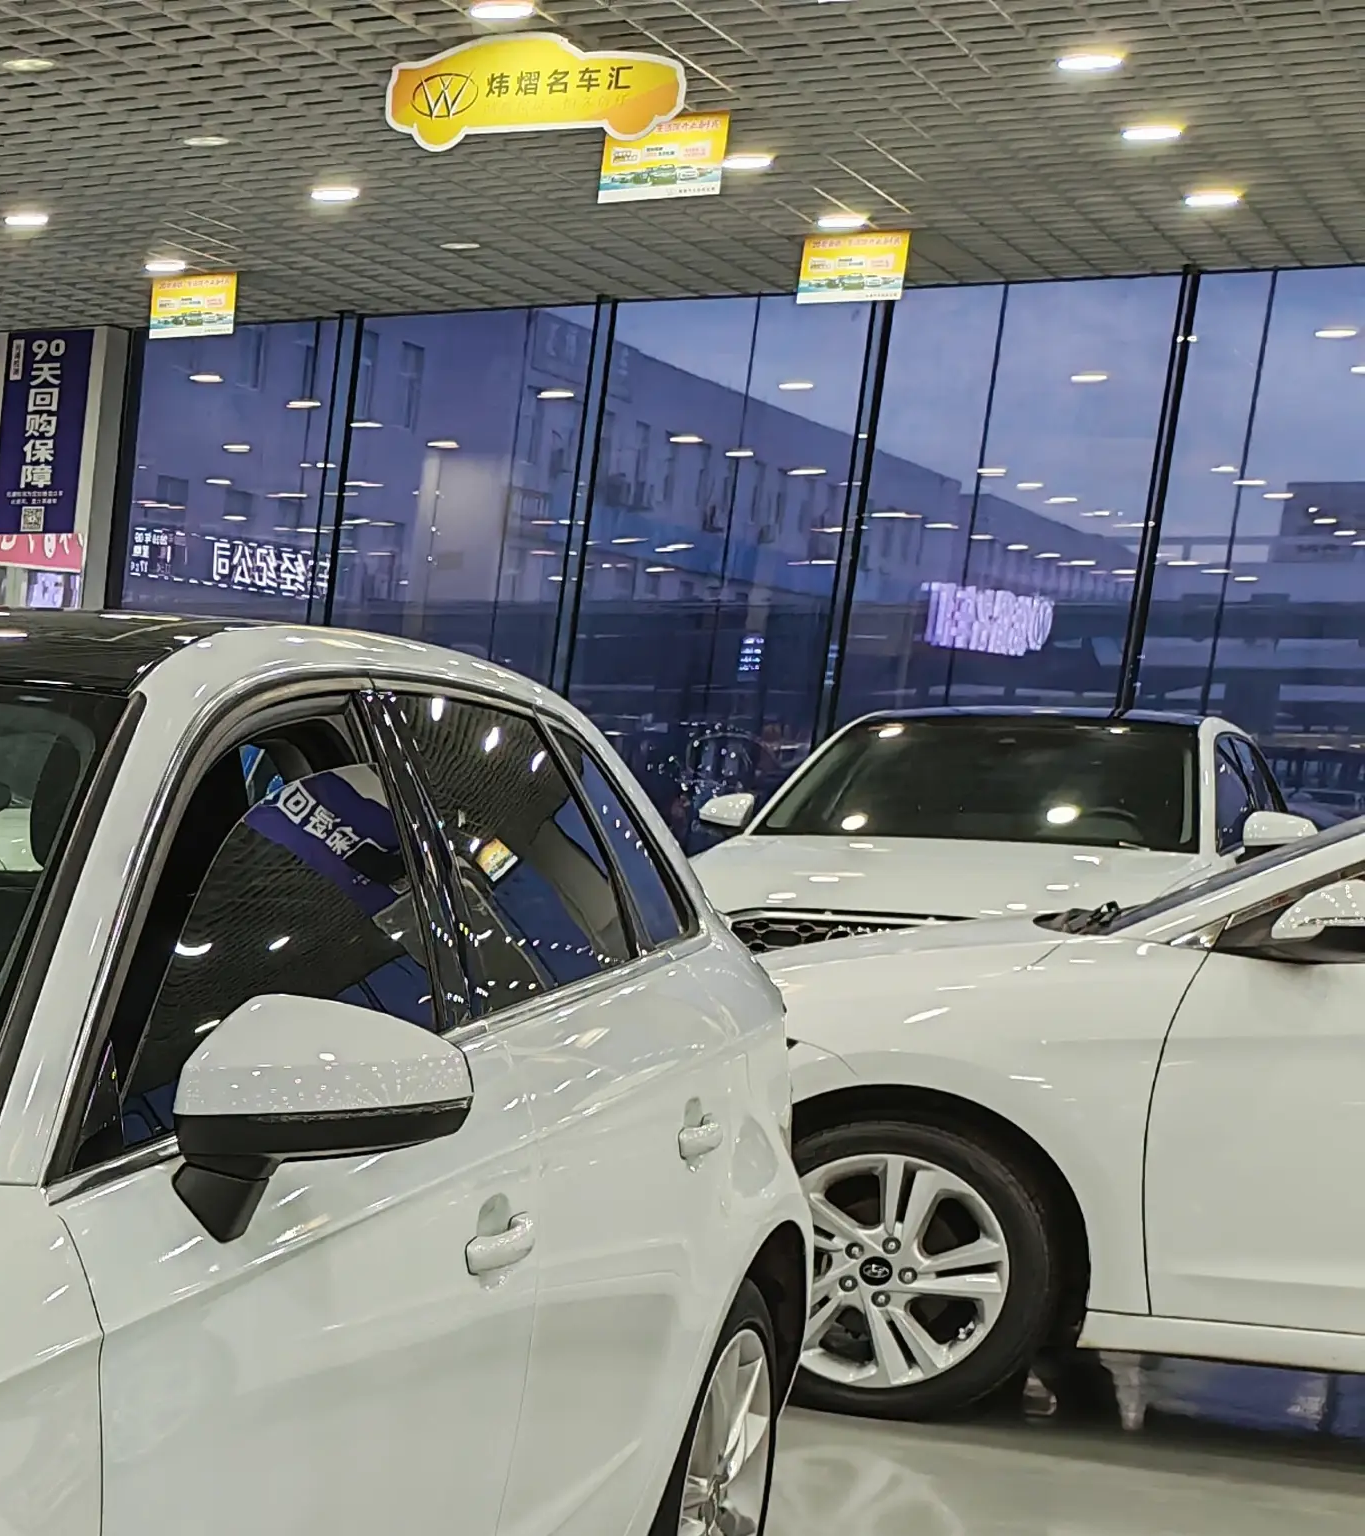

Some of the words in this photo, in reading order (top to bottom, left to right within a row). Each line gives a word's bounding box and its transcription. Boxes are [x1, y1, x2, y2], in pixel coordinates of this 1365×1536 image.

[485, 64, 635, 98] 炜熠名车汇
